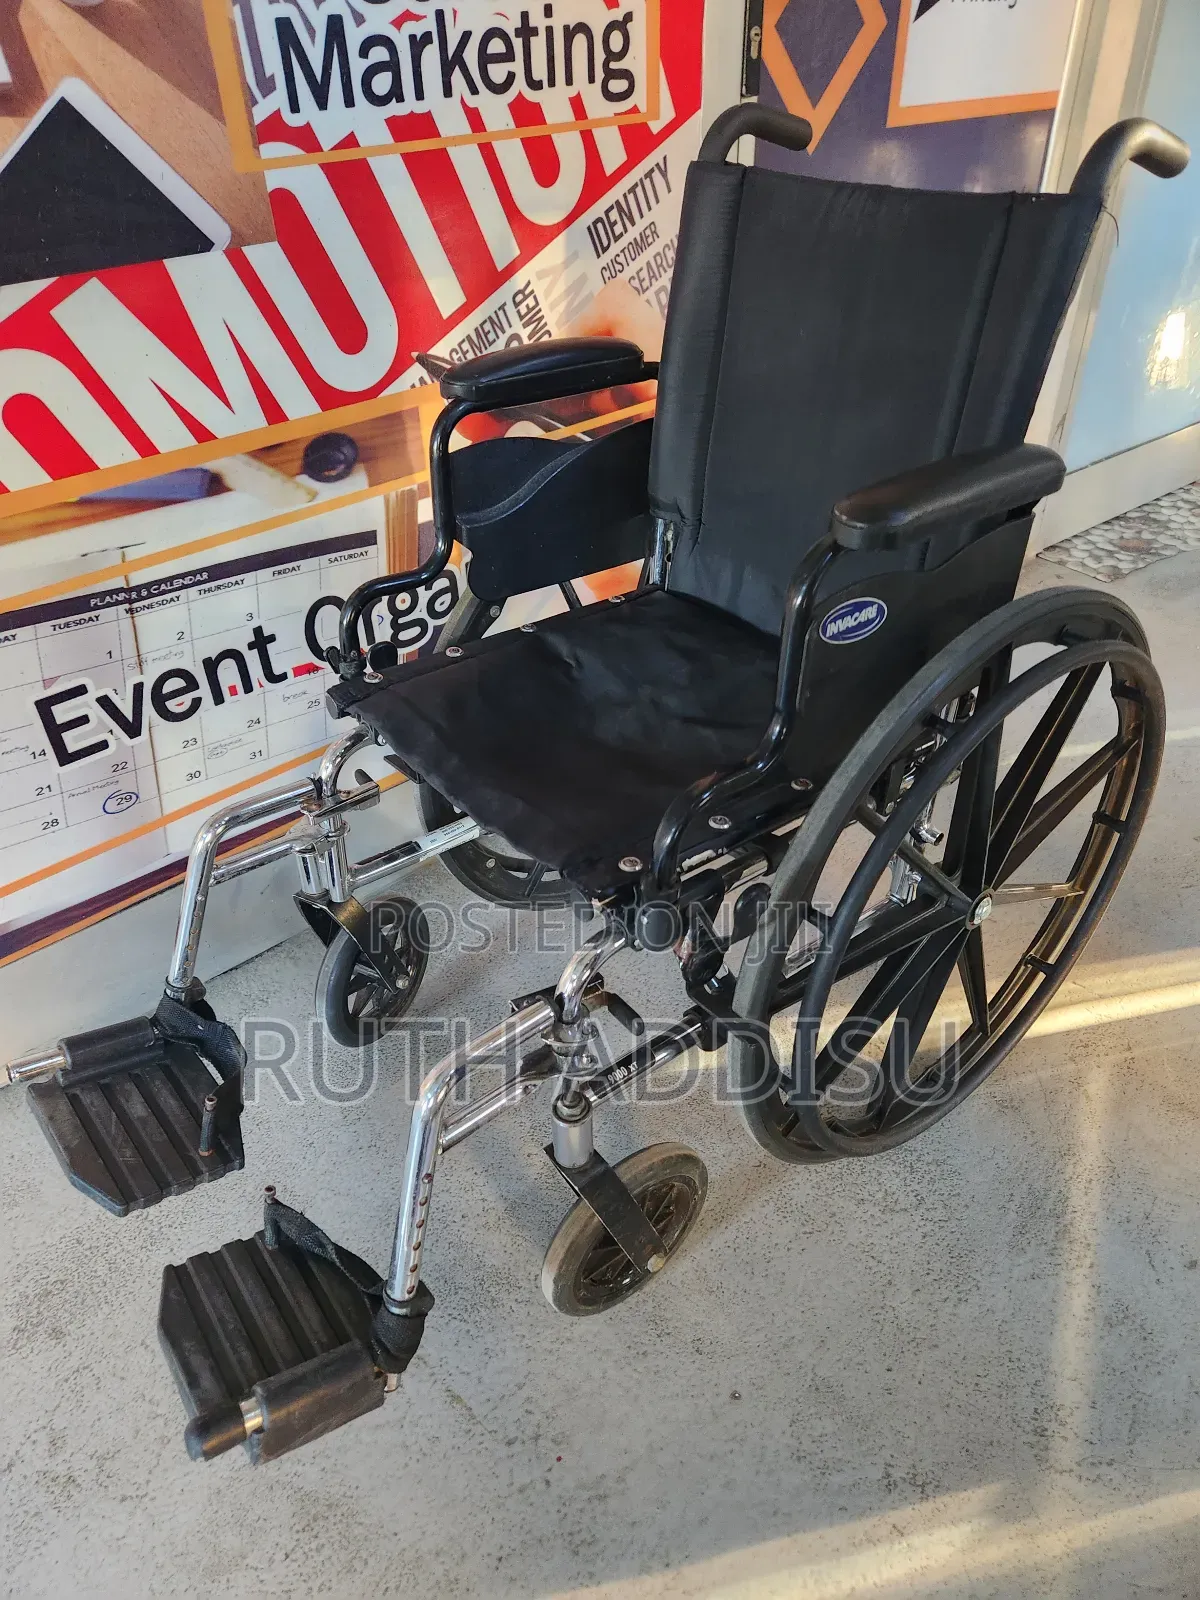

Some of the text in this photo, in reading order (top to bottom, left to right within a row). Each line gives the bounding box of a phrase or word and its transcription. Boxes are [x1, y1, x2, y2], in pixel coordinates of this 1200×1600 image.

[274, 3, 636, 114] Marketing
[586, 154, 672, 260] IDENTITY
[600, 221, 660, 285] CUSTOMER
[328, 550, 370, 565] SATURDAY
[272, 564, 302, 578] FRIDAY
[141, 588, 149, 597] &
[150, 571, 209, 595] CALENDAR
[197, 578, 246, 597] THURSDAY
[50, 614, 101, 632] TUESDAY
[246, 612, 255, 622] 3
[825, 603, 879, 638] INVACARE
[176, 631, 185, 641] 2
[106, 650, 113, 660] 1
[34, 624, 288, 768] Event
[306, 698, 321, 710] 25
[247, 717, 261, 729] 24
[182, 737, 198, 749] 23
[30, 748, 47, 760] 14
[249, 749, 263, 760] 31
[111, 761, 128, 773] 22
[186, 770, 202, 782] 30
[35, 784, 52, 797] 21
[115, 795, 133, 806] 29
[41, 818, 60, 831] 28
[607, 1066, 629, 1085] 9000
